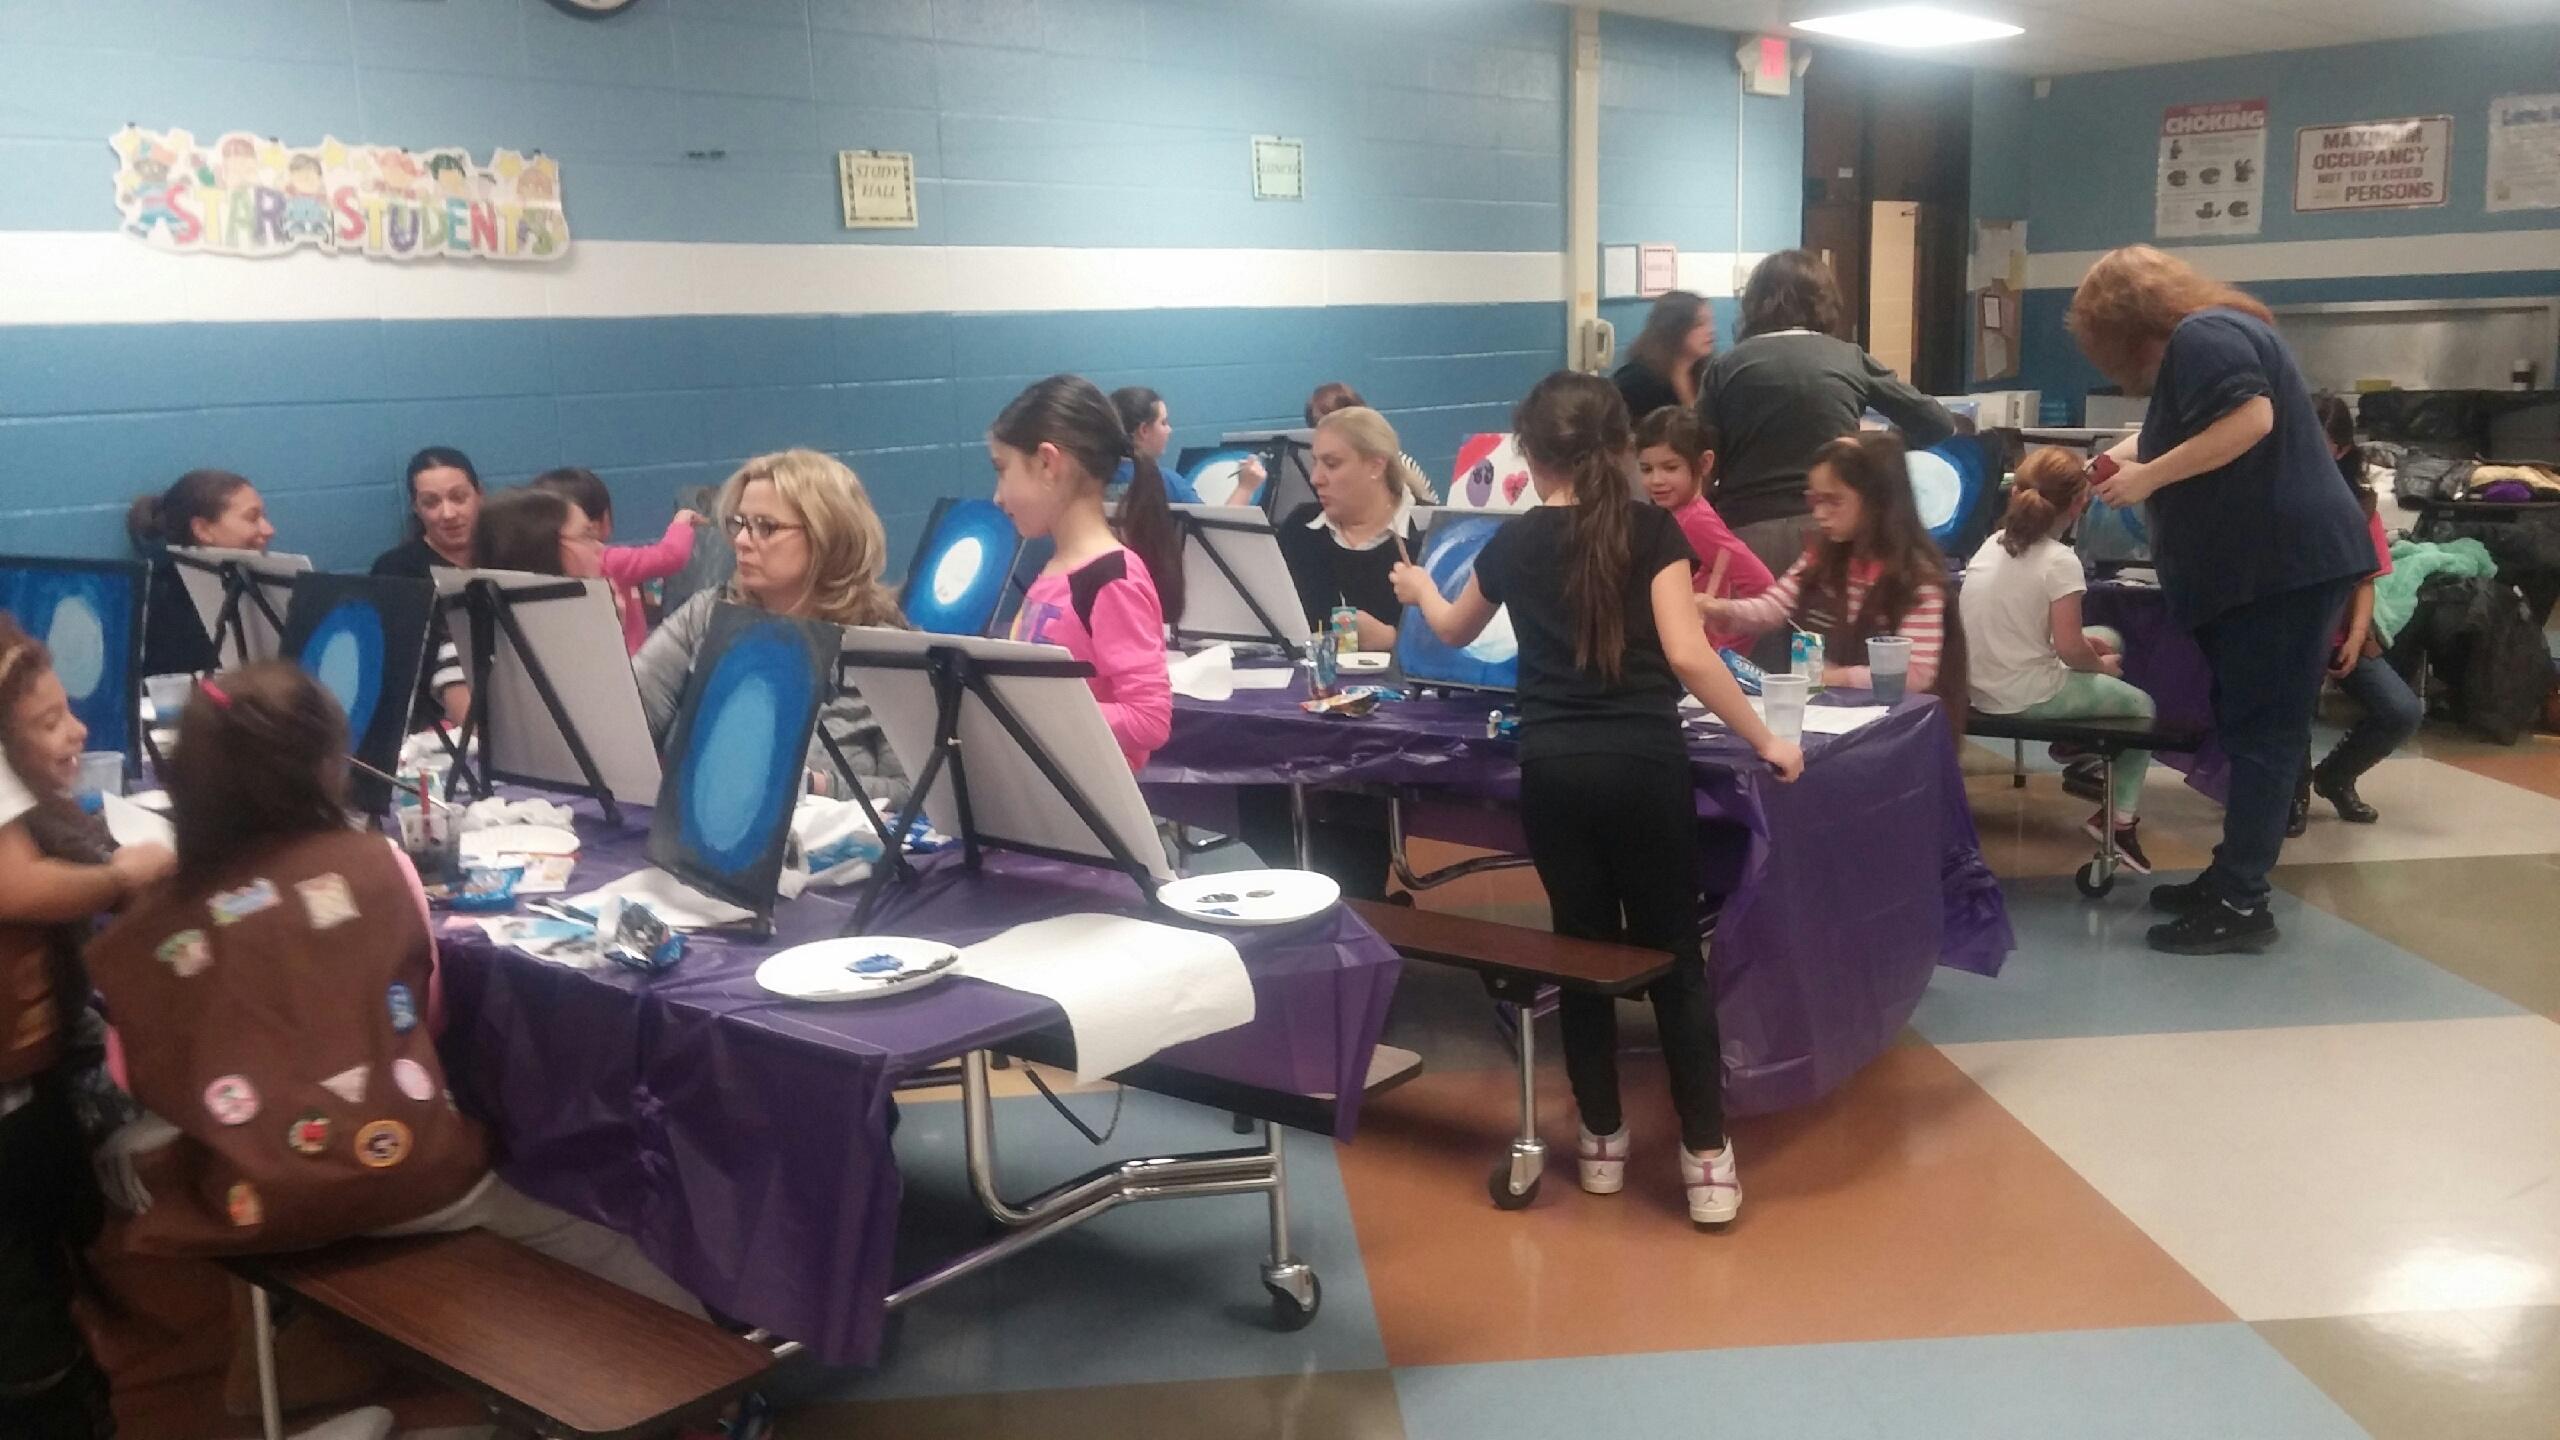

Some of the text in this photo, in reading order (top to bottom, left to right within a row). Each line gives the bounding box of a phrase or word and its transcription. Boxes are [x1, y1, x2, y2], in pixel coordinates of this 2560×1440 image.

[2165, 110, 2265, 134] CHOKING
[2313, 147, 2429, 170] OCCUPANCY
[2318, 167, 2423, 184] NOT TO EXCEED
[2346, 182, 2434, 202] PERSONS
[165, 183, 557, 256] STAR STUDENTS
